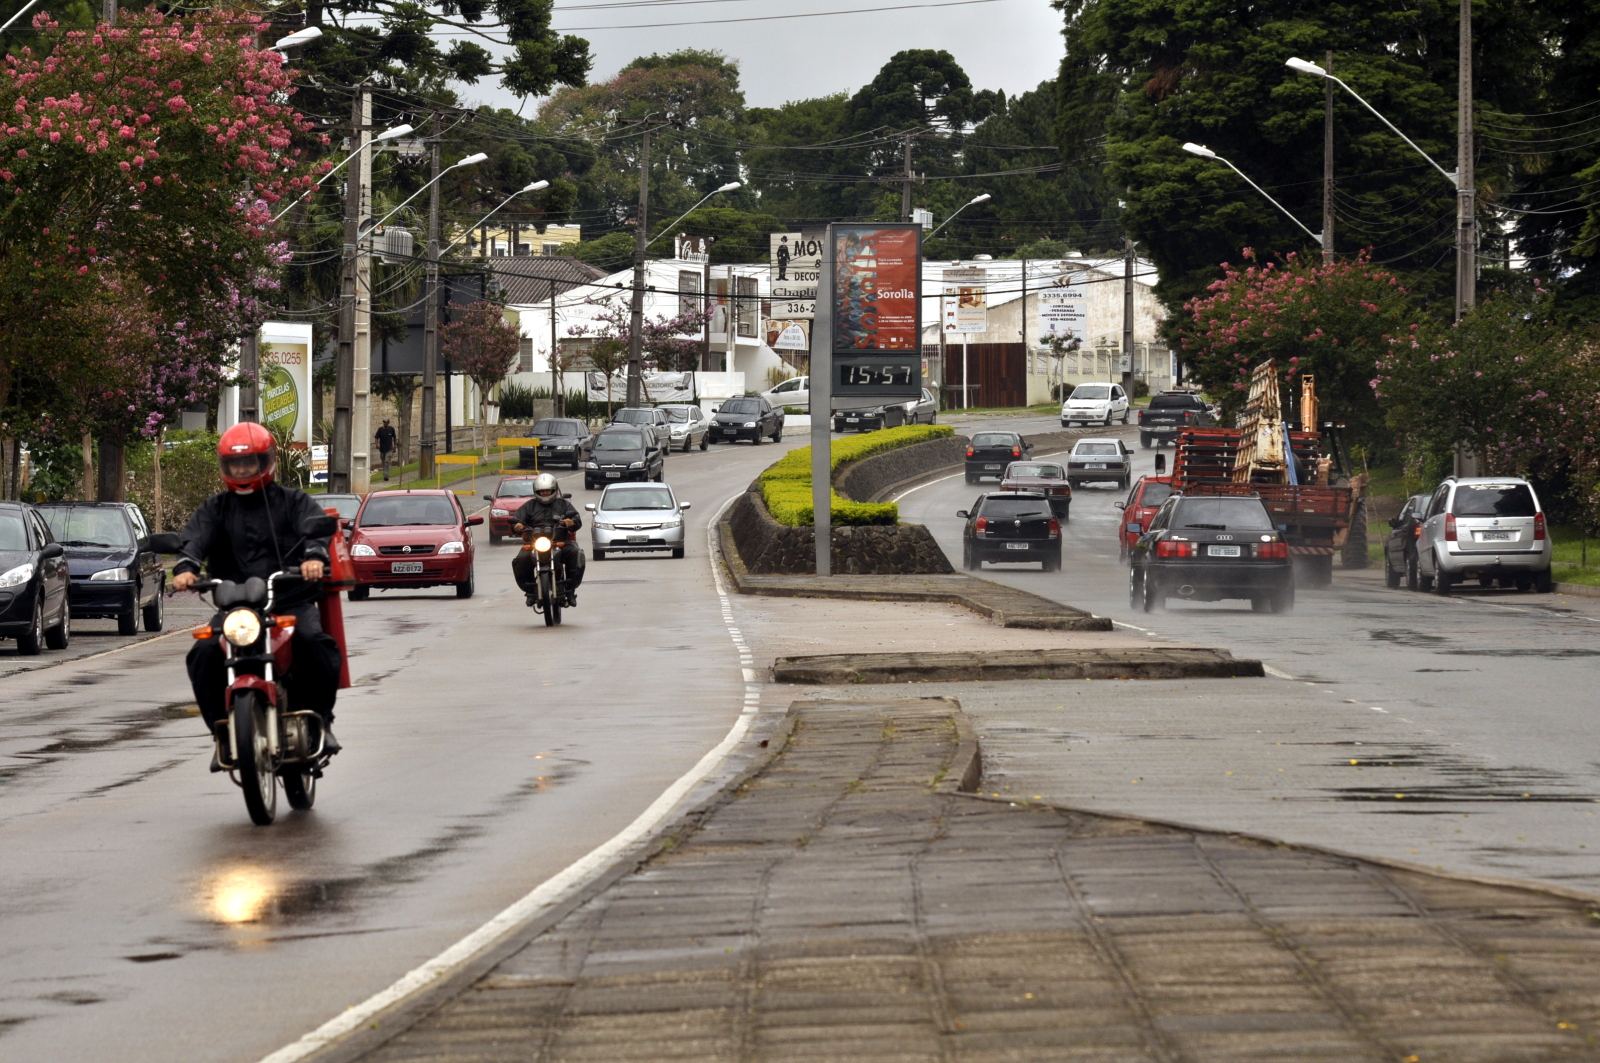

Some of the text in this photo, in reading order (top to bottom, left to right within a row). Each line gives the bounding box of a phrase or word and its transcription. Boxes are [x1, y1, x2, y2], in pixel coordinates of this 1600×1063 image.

[877, 289, 914, 299] Sorolla
[850, 366, 911, 384] 15:57
[267, 382, 290, 400] PARCELAS
[265, 390, 296, 414] QUE CABEM
[281, 403, 296, 416] BOLSO
